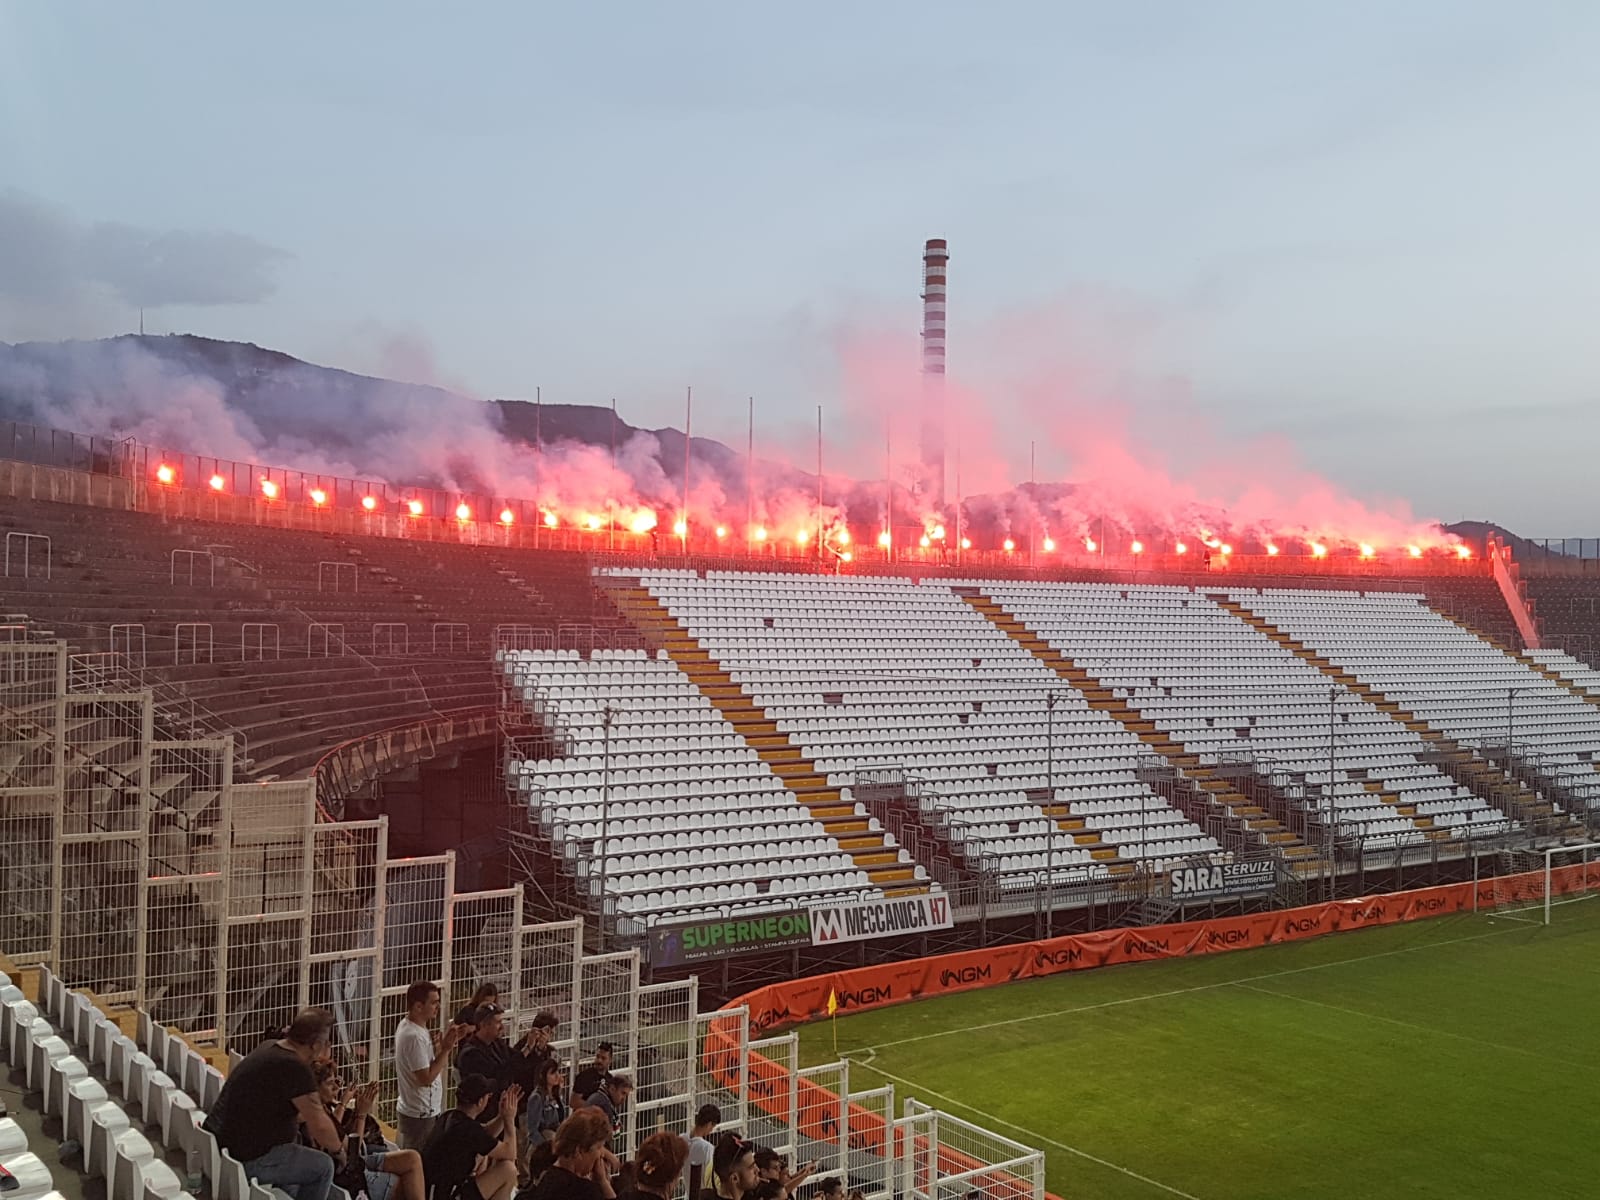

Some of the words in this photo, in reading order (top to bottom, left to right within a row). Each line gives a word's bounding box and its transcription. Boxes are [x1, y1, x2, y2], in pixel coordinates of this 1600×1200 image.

[1223, 861, 1274, 876] SERVIZI
[1172, 867, 1223, 893] SARA
[844, 900, 928, 936] MECCANICA
[929, 897, 946, 925] H7
[1286, 918, 1320, 934] NGM
[682, 913, 809, 950] SUPERNEON
[1210, 928, 1249, 944] NGM
[1037, 949, 1082, 968] NGM
[942, 964, 991, 986] NGM
[840, 984, 892, 1008] NGM
